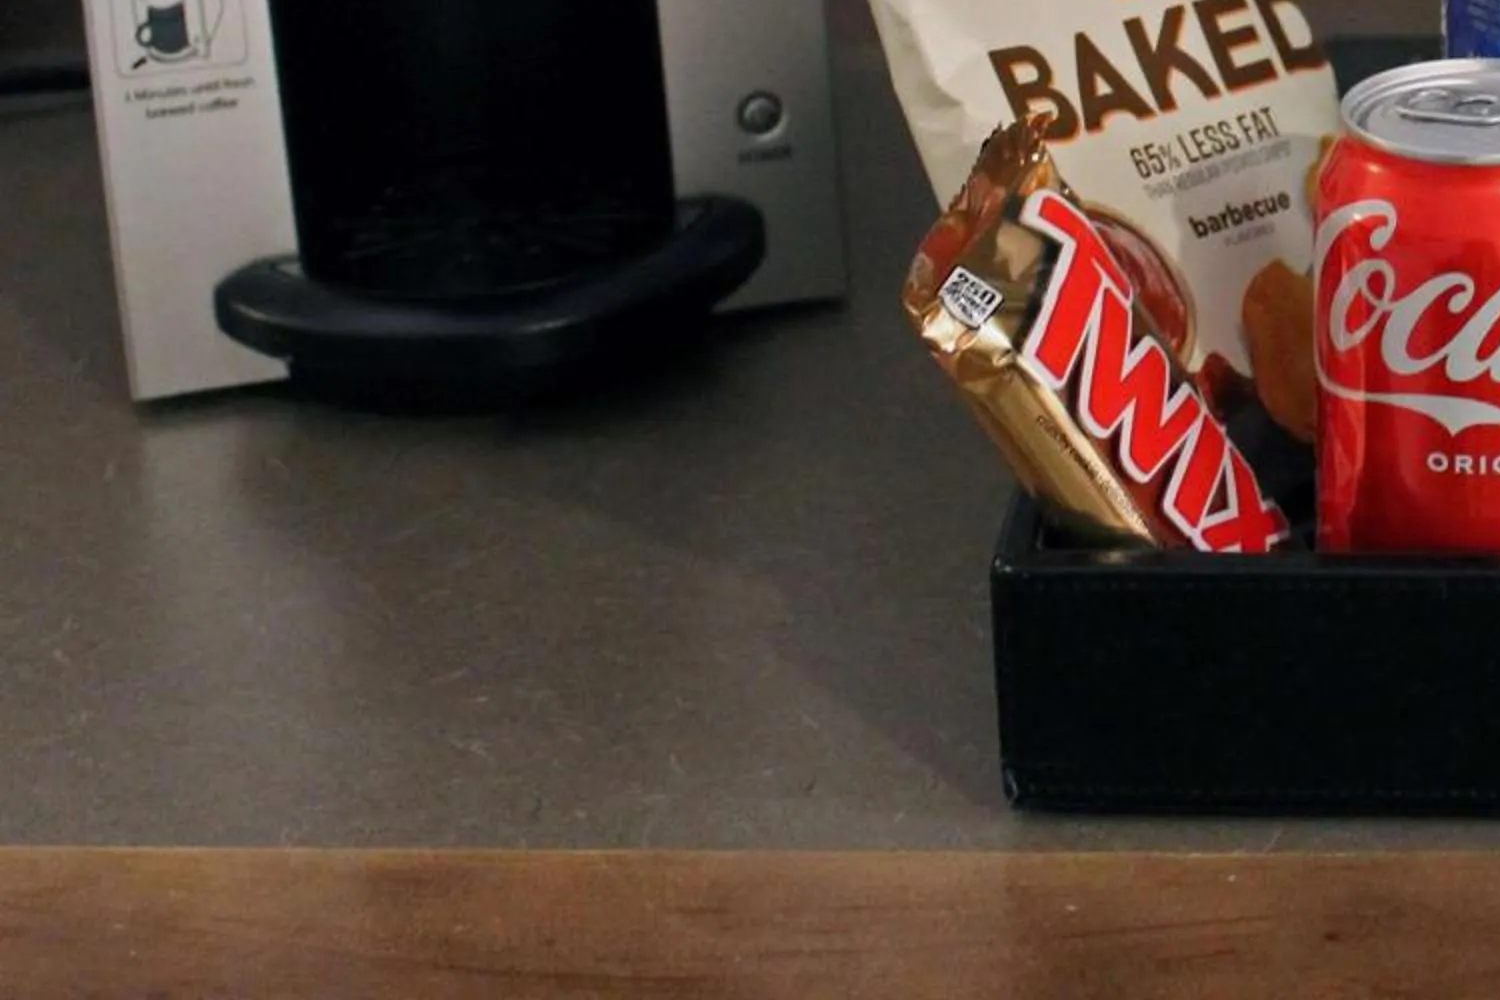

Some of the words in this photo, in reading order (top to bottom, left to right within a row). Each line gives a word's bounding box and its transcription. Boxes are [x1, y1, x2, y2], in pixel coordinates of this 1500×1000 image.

[1130, 141, 1182, 180] 65%
[1176, 120, 1241, 164] LESS
[1235, 106, 1280, 145] FAT
[1188, 192, 1292, 240] barbecue
